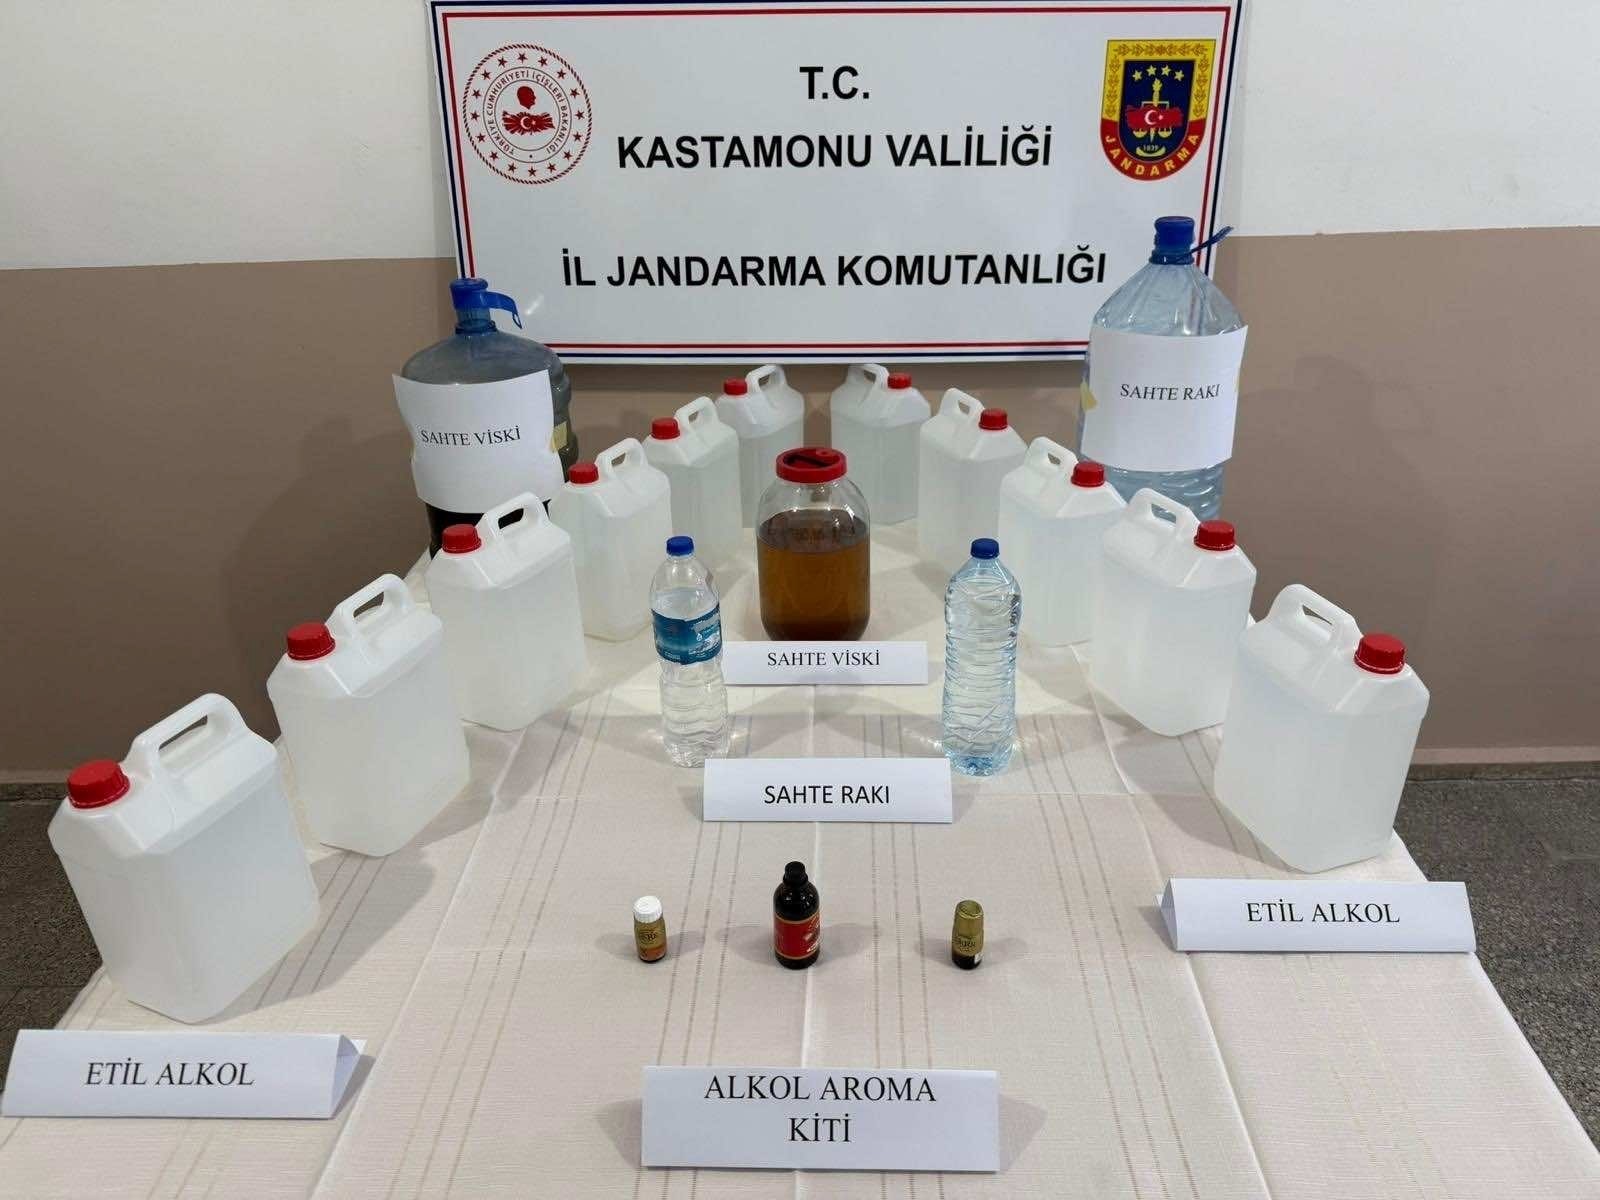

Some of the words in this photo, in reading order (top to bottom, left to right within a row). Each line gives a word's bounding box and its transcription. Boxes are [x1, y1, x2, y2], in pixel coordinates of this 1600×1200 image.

[487, 70, 530, 116] CUMHURİYETİ
[799, 66, 870, 100] T.C.
[487, 117, 515, 156] TÜRKİYE
[545, 105, 569, 155] BAKANLIĞI
[618, 134, 872, 169] KASTAMONU
[884, 124, 1053, 168] VALİLİĞİ
[1104, 133, 1200, 177] JANDARMA
[561, 247, 597, 287] İL
[606, 255, 827, 287] JANDARMA
[837, 244, 1107, 287] KOMUTANLIĞI
[1119, 383, 1178, 401] SAHTE
[1182, 383, 1221, 400] RAKI
[420, 427, 471, 448] SAHTE
[473, 424, 522, 446] VİSKİ
[767, 651, 826, 668] SAHTE
[831, 648, 881, 668] VİSKİ
[763, 785, 834, 805] SAHTE
[841, 785, 890, 805] RAKI
[1245, 898, 1305, 923] ETİL
[1311, 903, 1401, 924] ALKOL
[85, 1057, 148, 1086] ETİL
[154, 1062, 255, 1086] ALKOL
[704, 1075, 812, 1102] ALKOL
[818, 1075, 937, 1102] AROMA
[788, 1112, 852, 1143] KİTİ
